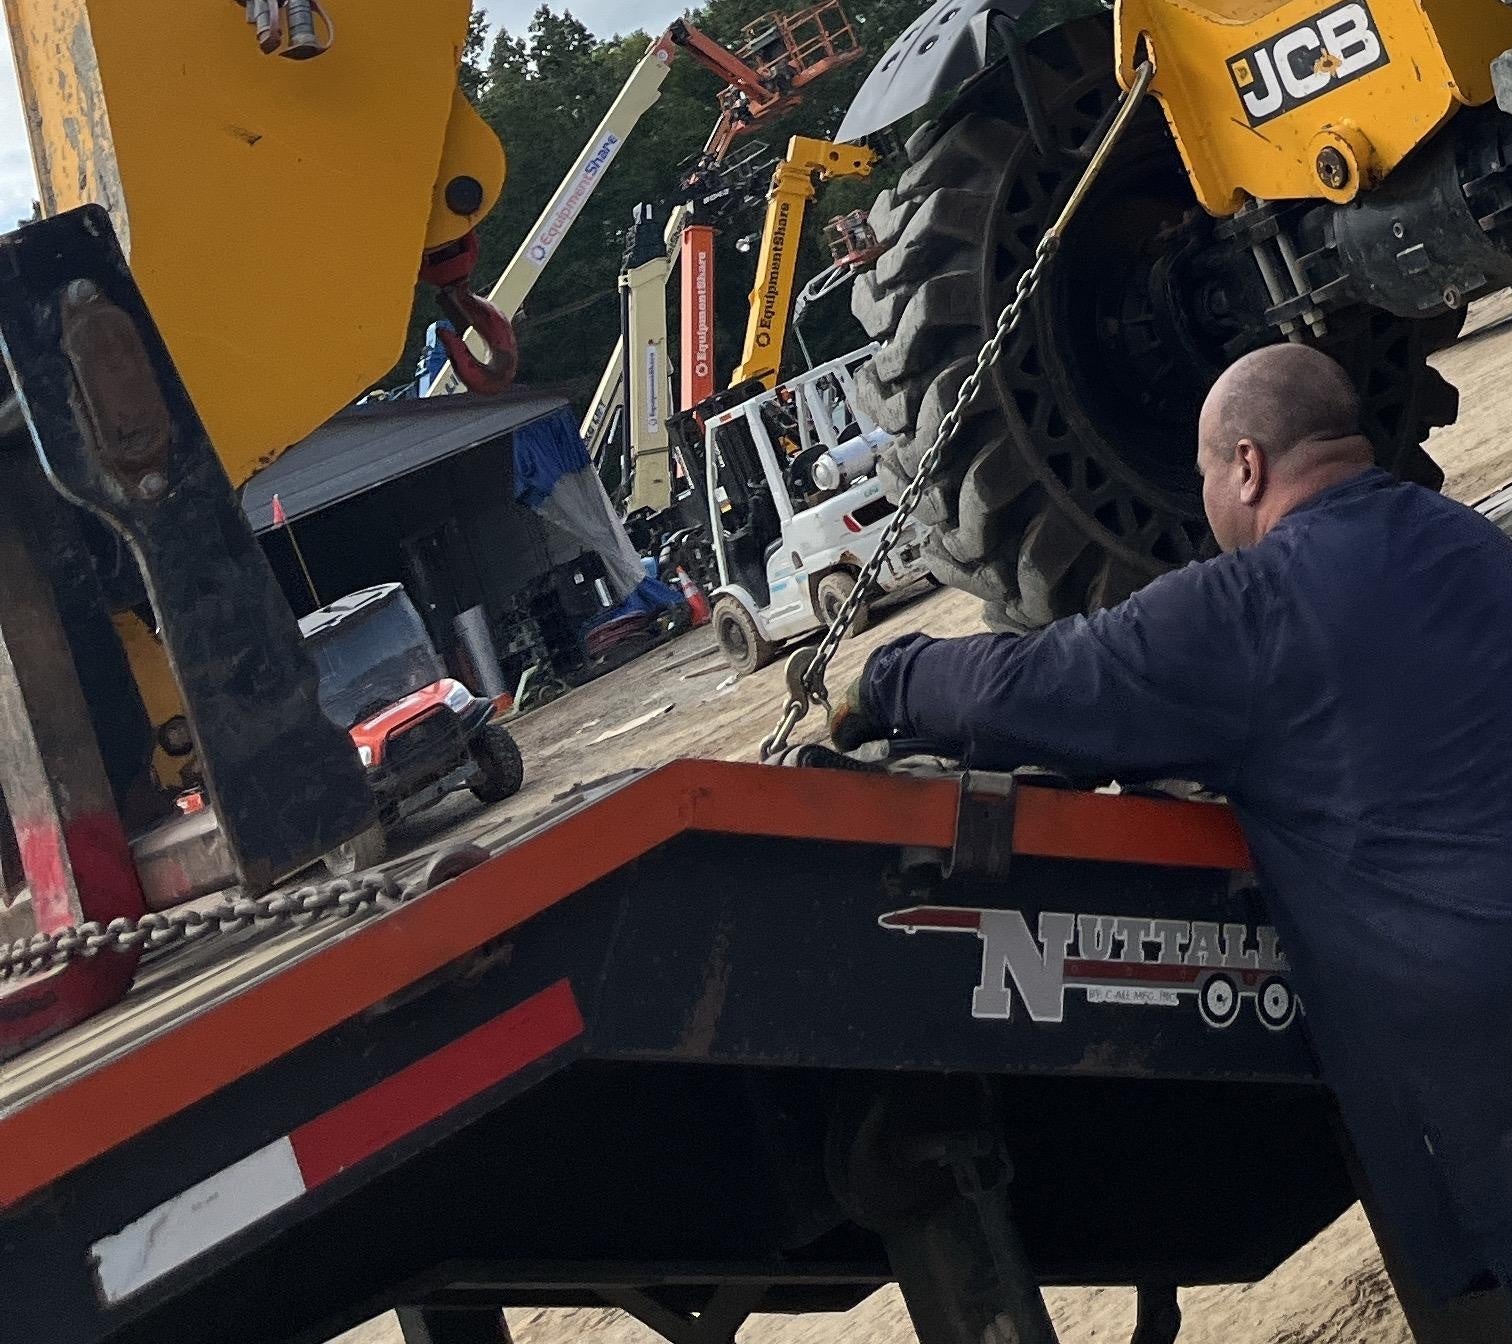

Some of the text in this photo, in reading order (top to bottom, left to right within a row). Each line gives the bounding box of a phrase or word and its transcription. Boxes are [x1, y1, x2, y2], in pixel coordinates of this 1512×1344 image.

[1243, 2, 1382, 119] JCB
[540, 134, 618, 246] EquipmentShare
[696, 251, 709, 361] EquipmentShare
[759, 202, 790, 330] EquipmentShare
[972, 910, 1292, 1022] NUTTALL
